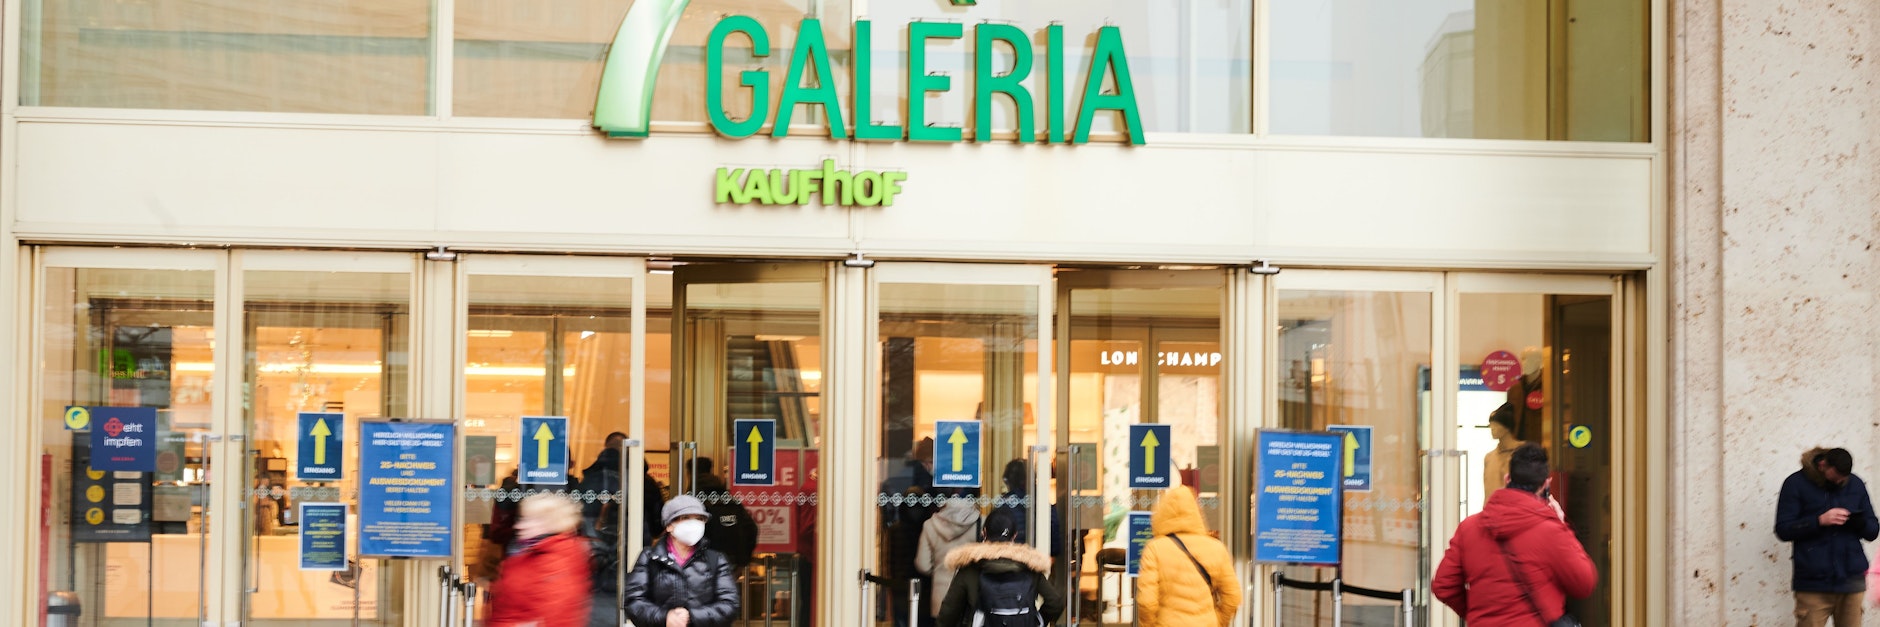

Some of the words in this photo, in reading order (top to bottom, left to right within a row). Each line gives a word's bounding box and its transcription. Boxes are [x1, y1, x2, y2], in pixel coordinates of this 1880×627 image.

[705, 14, 1146, 146] GALERIA
[1101, 351, 1222, 367] LONCHAMP
[103, 436, 142, 448] impfen
